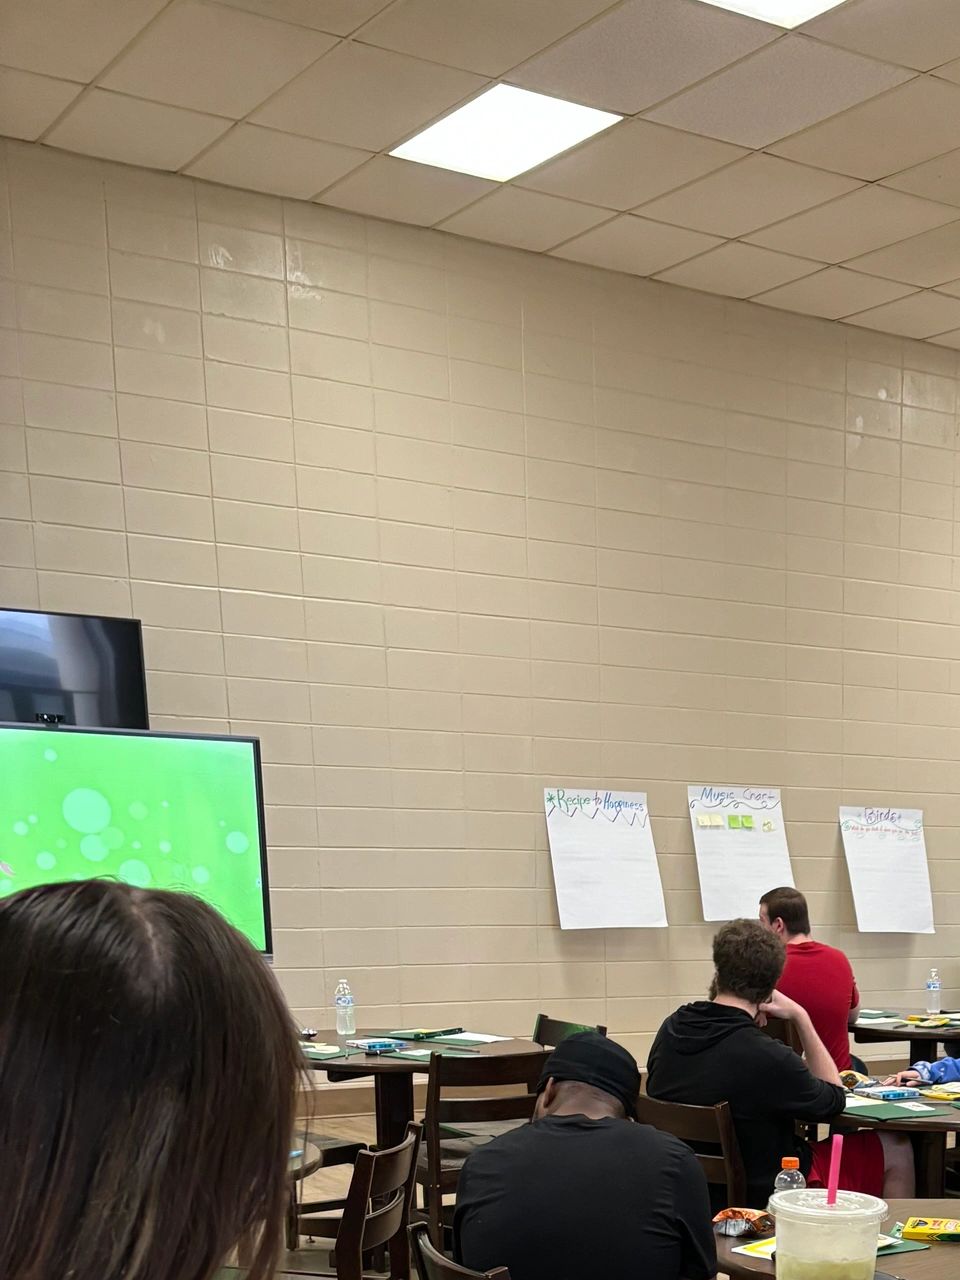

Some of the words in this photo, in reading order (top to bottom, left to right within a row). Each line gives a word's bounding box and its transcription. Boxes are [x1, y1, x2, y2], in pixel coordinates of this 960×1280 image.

[557, 789, 591, 812] Recipe
[593, 791, 602, 806] to
[604, 792, 644, 813] Happiness
[700, 787, 735, 803] Music
